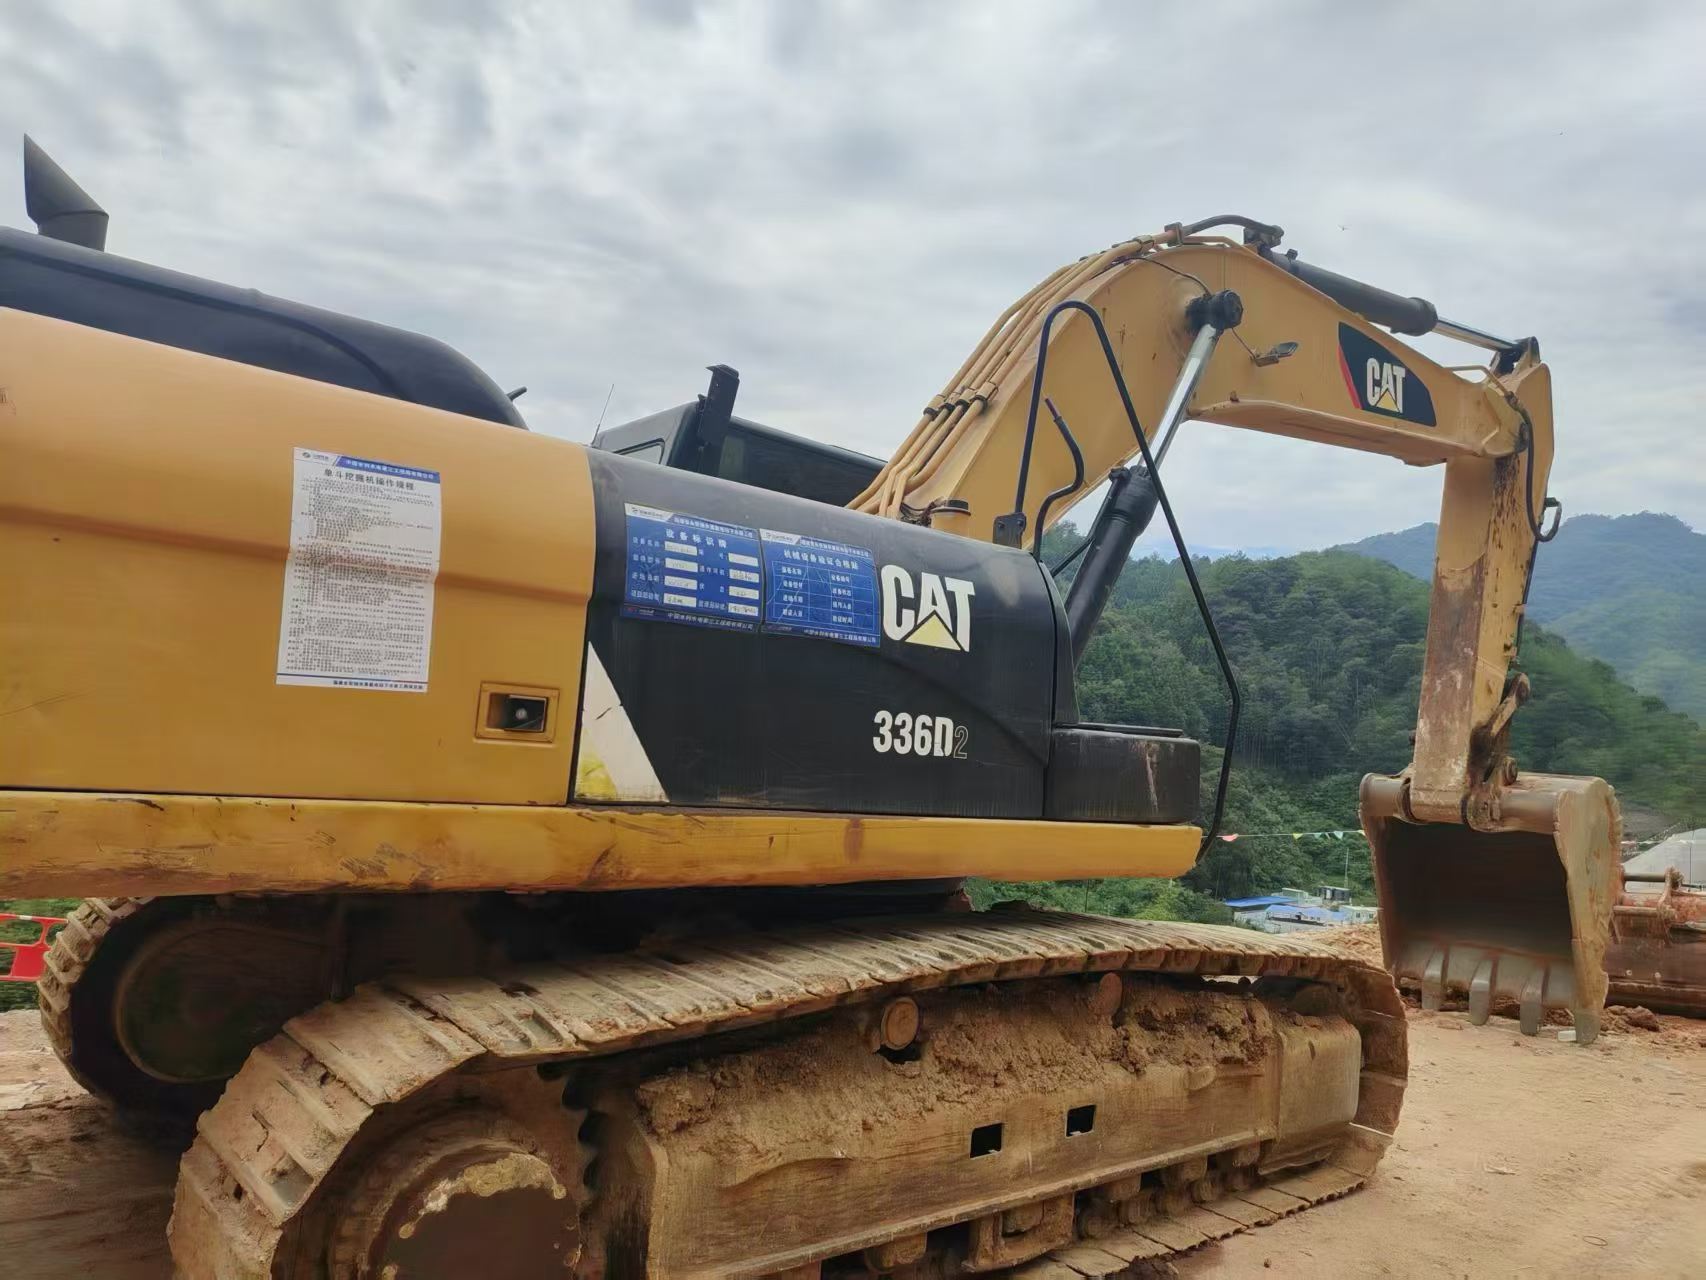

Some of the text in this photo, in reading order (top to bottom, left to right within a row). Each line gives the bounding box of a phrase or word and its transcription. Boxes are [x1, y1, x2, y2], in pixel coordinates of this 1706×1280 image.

[1366, 357, 1406, 413] CAT
[324, 468, 415, 491] 单斗挖掘机操作规程
[880, 564, 976, 652] CAT
